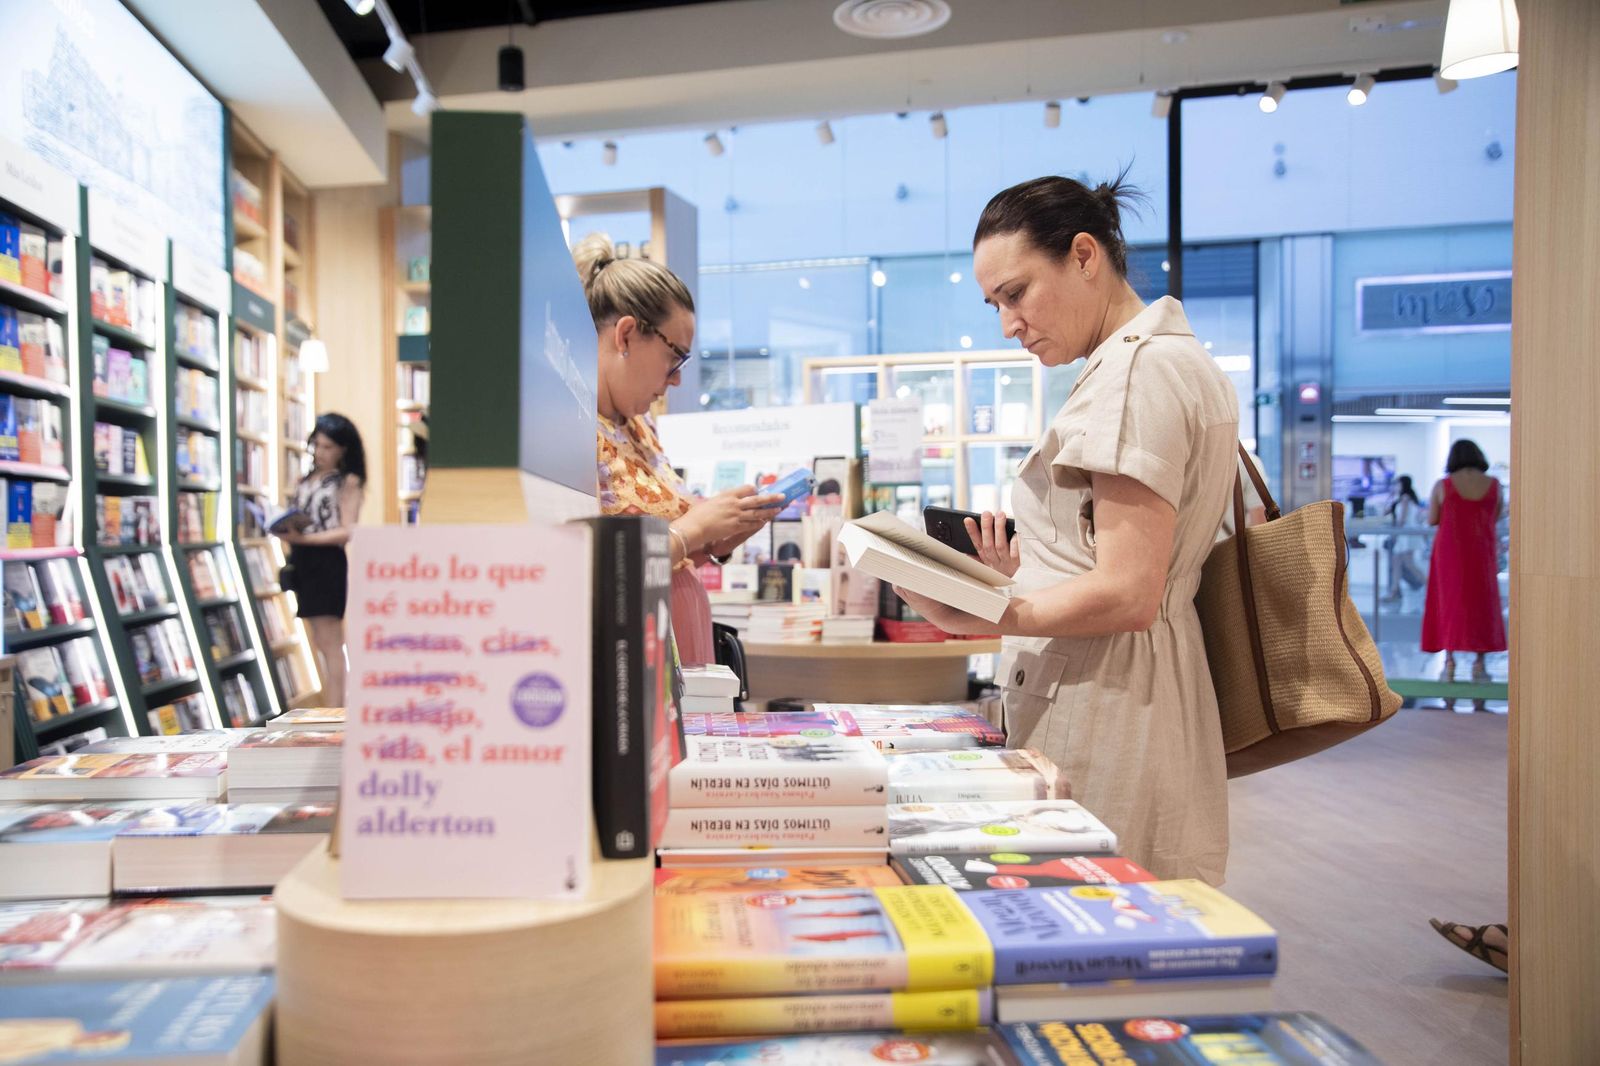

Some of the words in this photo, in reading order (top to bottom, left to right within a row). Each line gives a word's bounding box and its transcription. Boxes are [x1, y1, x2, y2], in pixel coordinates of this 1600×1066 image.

[366, 554, 440, 580] todo
[449, 554, 479, 580] lo
[488, 564, 546, 588] que
[365, 591, 397, 615] sé
[408, 590, 495, 615] sobre
[443, 735, 471, 762] el
[482, 744, 566, 763] amor
[358, 770, 441, 809] dolly
[691, 777, 731, 791] BERLÍN
[735, 777, 750, 788] EN
[754, 777, 779, 790] DÍAS
[784, 776, 831, 790] ÚLTIMOS
[357, 807, 495, 835] alderton
[691, 819, 731, 833] BERLÍN
[735, 819, 750, 830] EN
[754, 818, 779, 832] DÍAS
[784, 818, 831, 832] ÚLTIMOS
[1087, 956, 1143, 972] Megan
